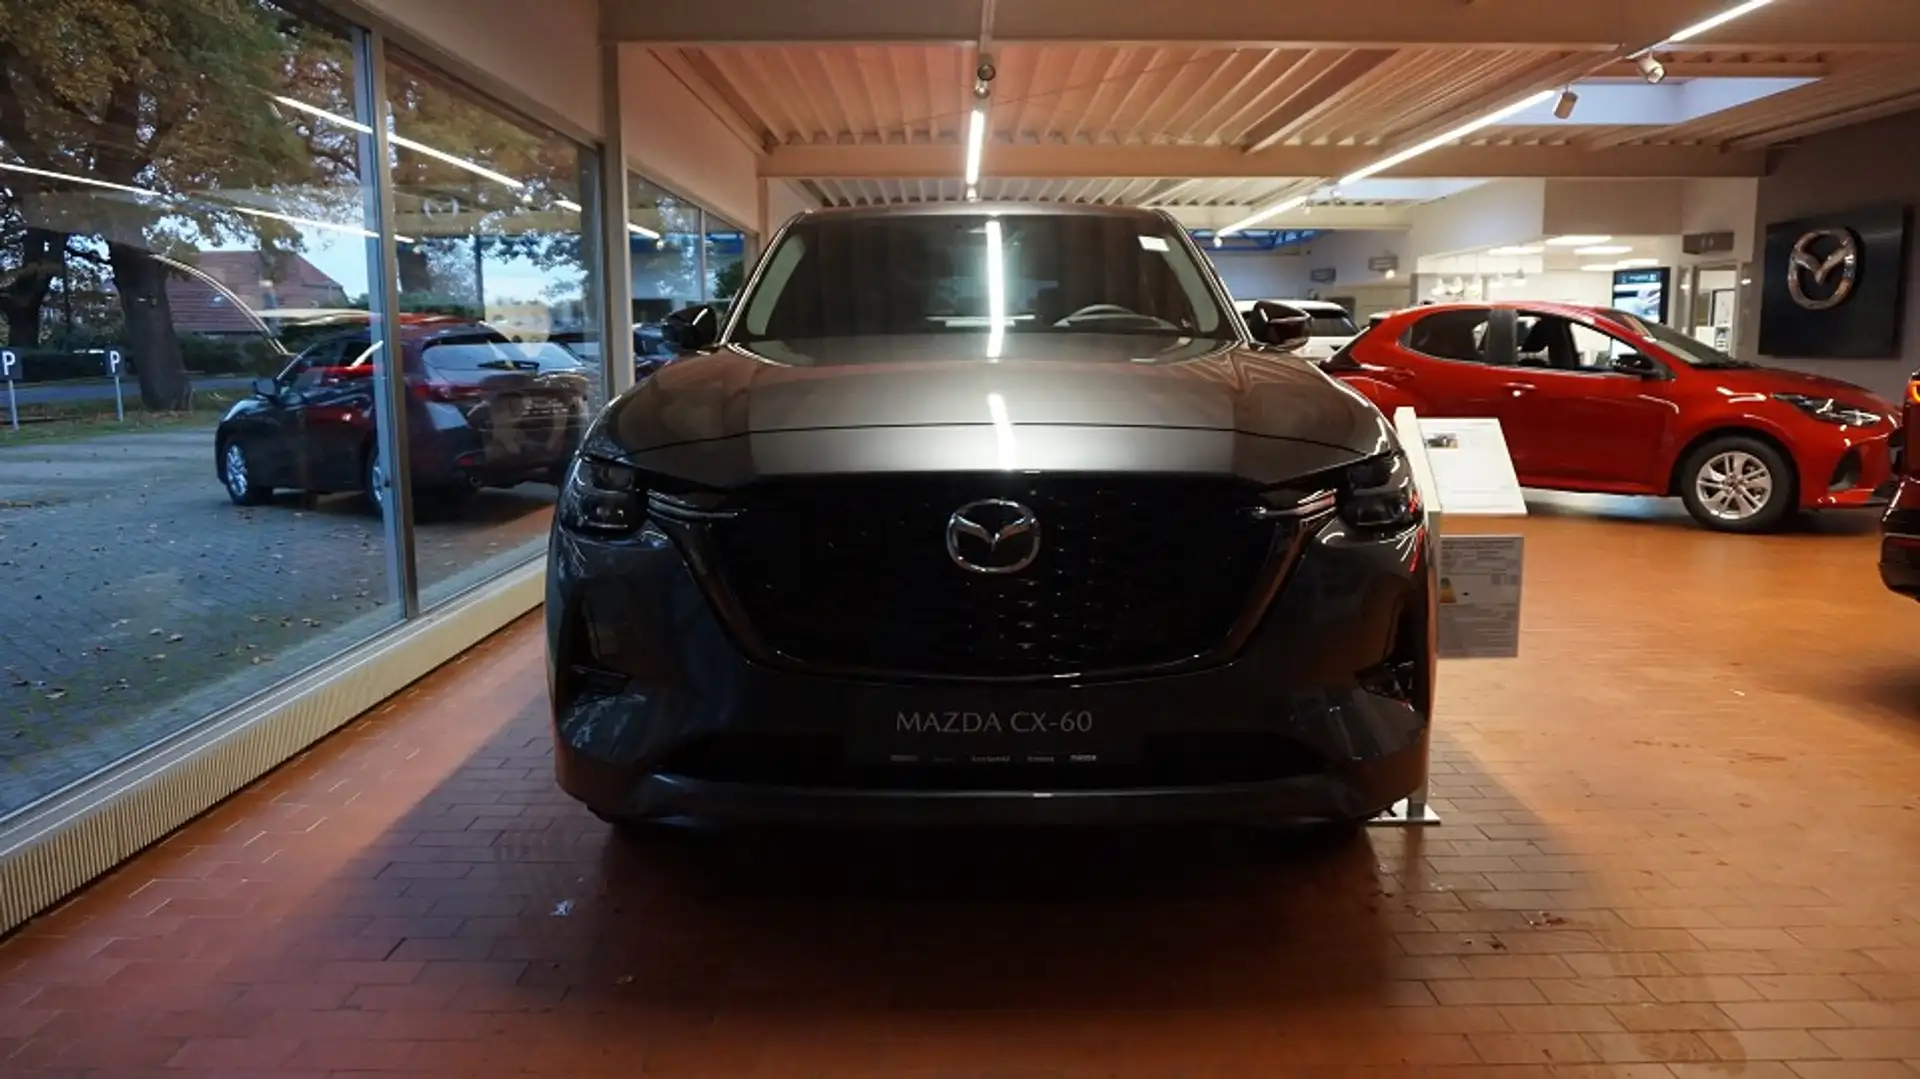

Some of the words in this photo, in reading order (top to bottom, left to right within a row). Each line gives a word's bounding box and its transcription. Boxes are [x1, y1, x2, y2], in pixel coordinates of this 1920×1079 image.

[2, 350, 16, 376] P
[109, 350, 121, 374] P
[896, 711, 1002, 732] MAZDA
[1010, 711, 1093, 732] CX-60
